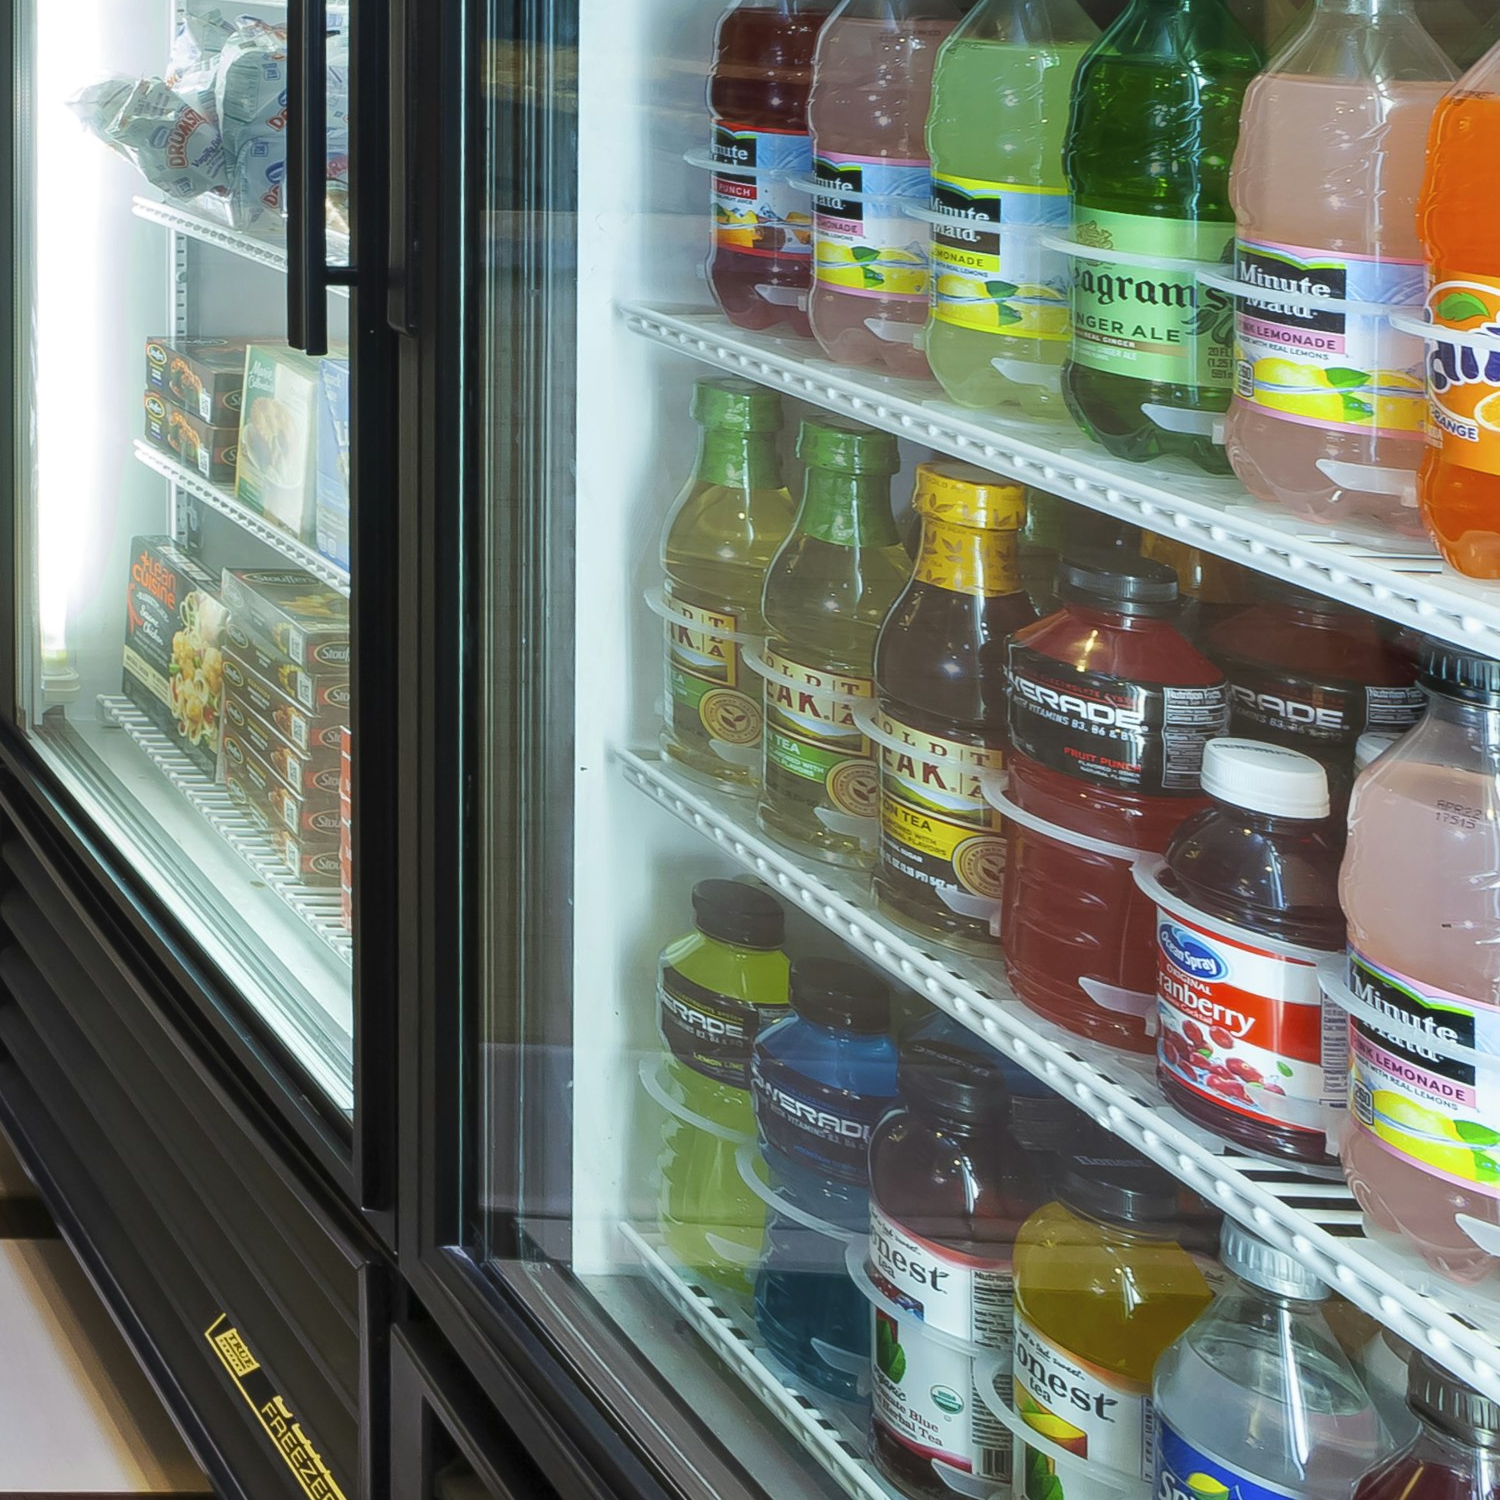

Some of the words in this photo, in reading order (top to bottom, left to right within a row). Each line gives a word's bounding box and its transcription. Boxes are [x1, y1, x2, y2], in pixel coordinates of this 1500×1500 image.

[717, 182, 752, 198] PUNCH
[1239, 260, 1332, 299] Minute
[1101, 336, 1136, 349] GINGER
[1131, 325, 1181, 343] ALE
[1256, 323, 1337, 351] LEMONADE
[1208, 346, 1220, 357] 20
[1268, 342, 1290, 356] REAL
[1289, 347, 1330, 362] LEMONS
[776, 735, 801, 756] TEA
[1063, 747, 1098, 763] FRUIT
[1099, 756, 1142, 772] PUNCH
[902, 811, 933, 833] TEA
[1435, 812, 1476, 830] 17515
[1436, 800, 1482, 820] APR22
[1161, 929, 1186, 962] Ocean
[1184, 948, 1217, 975] Spray
[1166, 963, 1213, 997] ORIGINAL
[1158, 972, 1256, 1038] ranberry
[1355, 977, 1459, 1045] Minute
[1374, 1050, 1466, 1103] LEMONADE
[1389, 1074, 1414, 1094] REAL
[1413, 1085, 1459, 1111] LEMONS
[878, 1257, 896, 1280] tea
[1014, 1340, 1118, 1423] onest
[1029, 1377, 1053, 1406] tea
[909, 1406, 939, 1433] Blue
[919, 1428, 943, 1448] Tea
